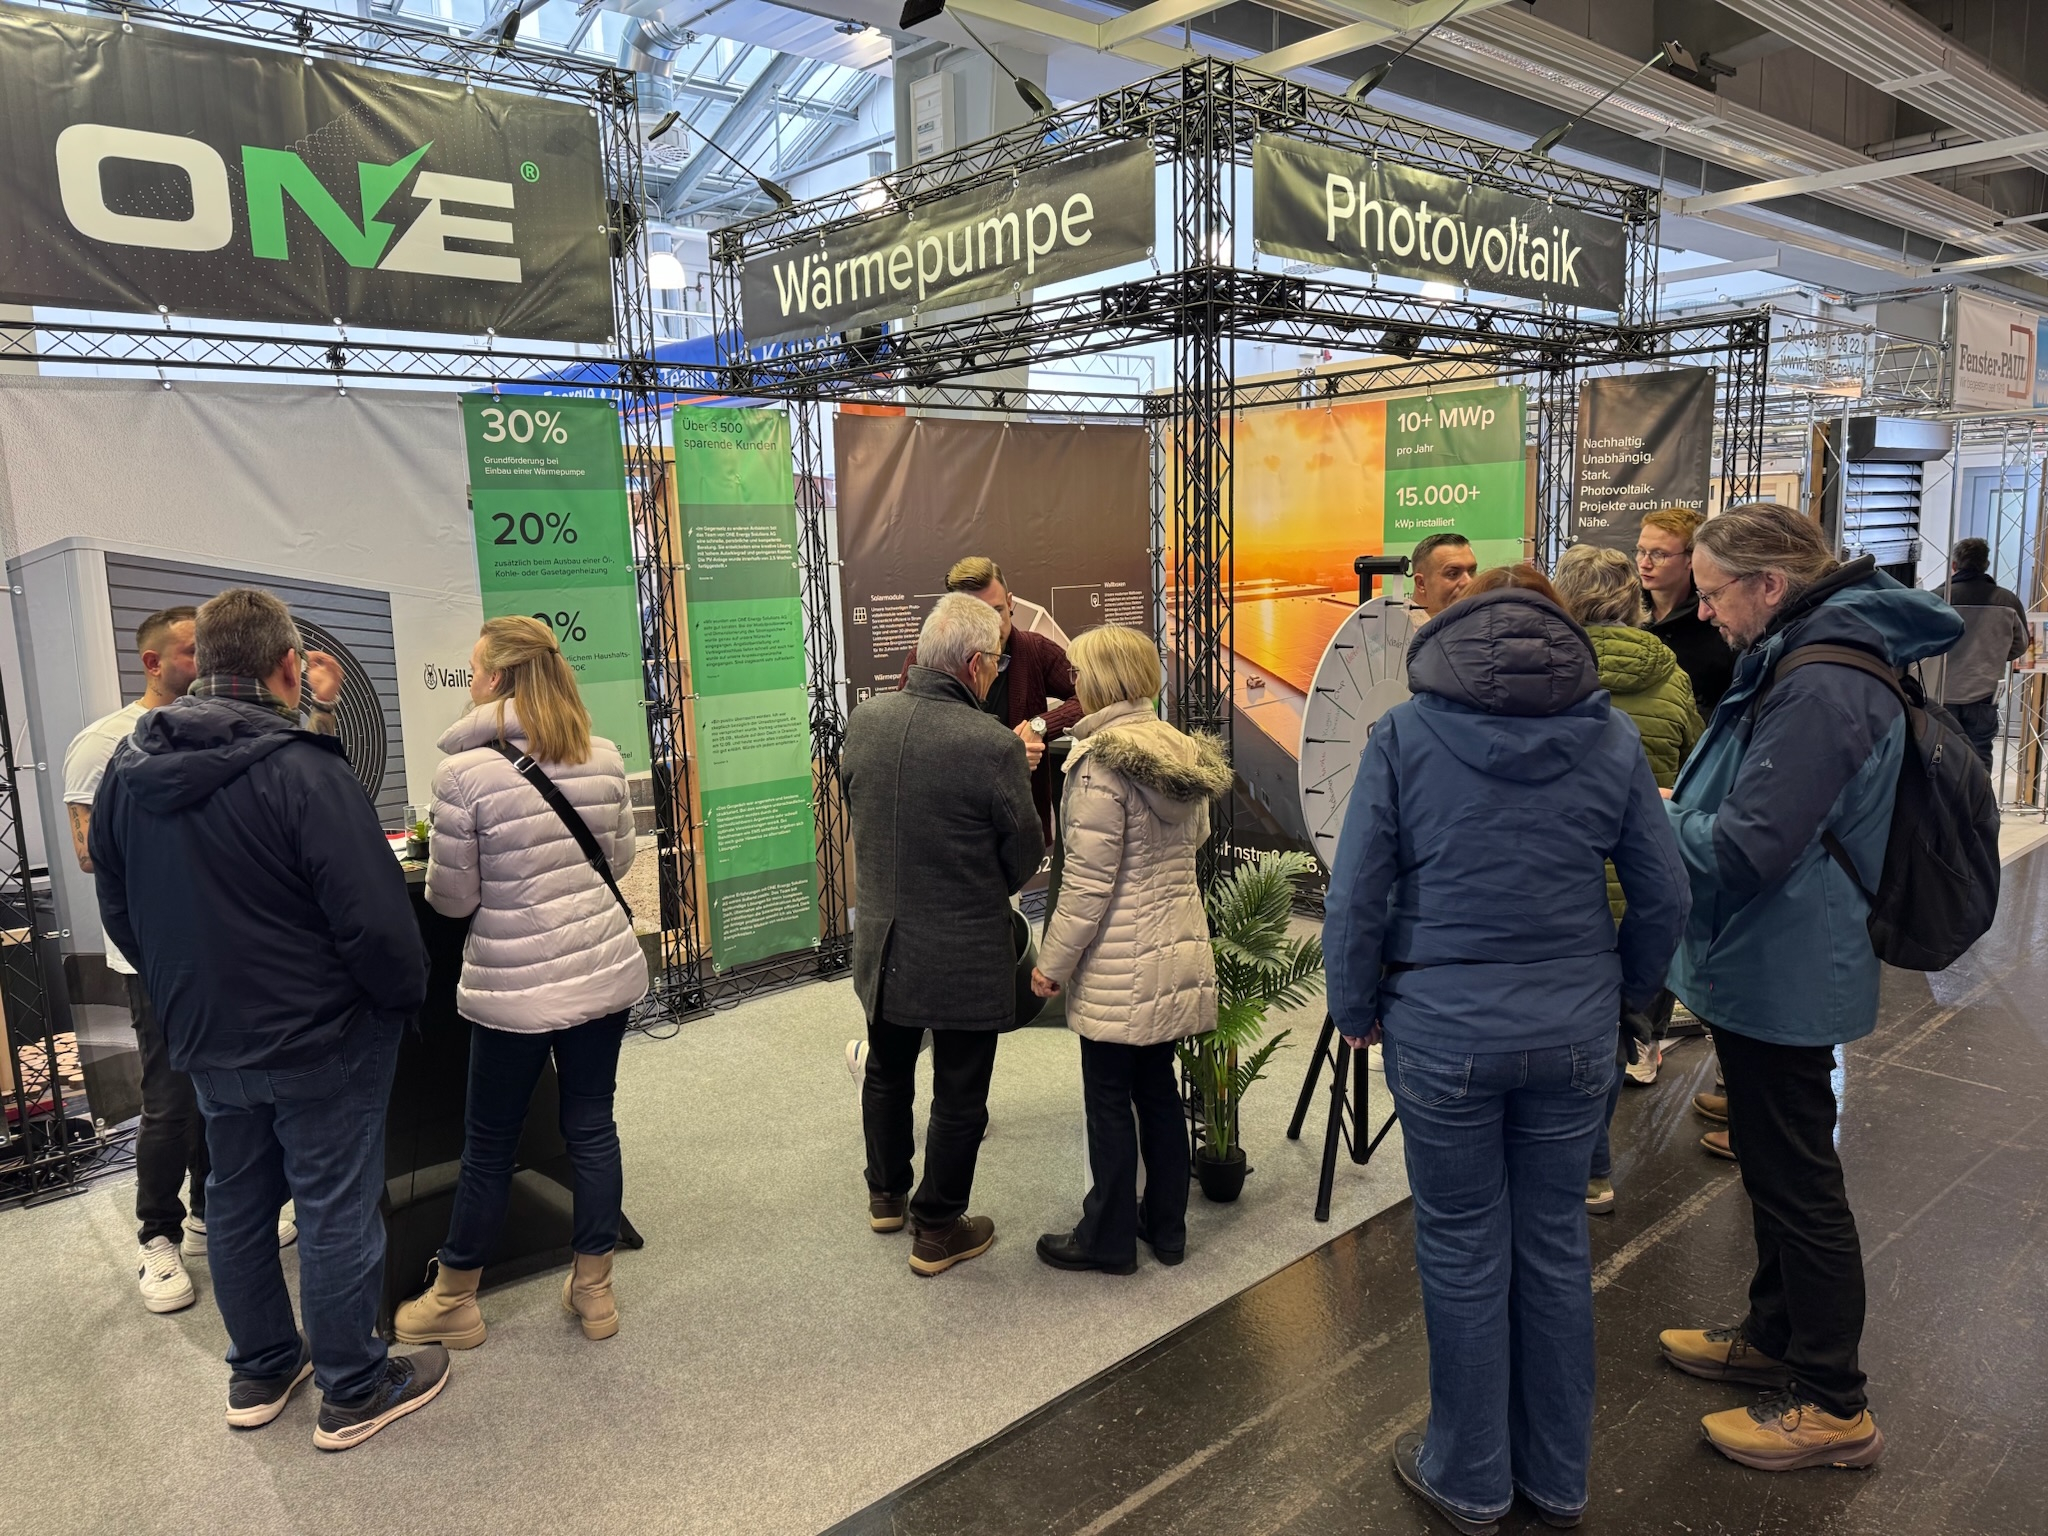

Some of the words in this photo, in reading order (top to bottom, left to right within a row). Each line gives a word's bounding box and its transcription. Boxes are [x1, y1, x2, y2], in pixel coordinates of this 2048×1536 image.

[1325, 173, 1582, 287] Photovoltaik
[773, 192, 1095, 317] Wärmepumpe
[1849, 338, 1860, 354] 22
[1958, 343, 2027, 382] Fenster-PAUL
[481, 408, 568, 444] 30%
[682, 419, 708, 433] Über
[711, 421, 743, 434] 3.500
[1397, 411, 1433, 434] 10+
[1439, 405, 1495, 432] MWp
[684, 438, 733, 450] sparende
[736, 438, 777, 450] Kunden
[1396, 446, 1412, 457] pro
[1413, 443, 1434, 455] Jahr
[1583, 436, 1645, 451] Nachhaltig.
[483, 456, 544, 467] Grundförderung
[546, 457, 559, 466] bei
[1582, 452, 1655, 467] Unabhängig.
[485, 467, 511, 476] Einbau
[513, 468, 532, 476] einer
[534, 467, 586, 478] Wärmepumpe
[1581, 469, 1611, 481] Stark.
[1396, 483, 1481, 507] 15.000+
[1580, 484, 1655, 497] Photovoltaik-
[1579, 500, 1627, 514] Projekte
[1629, 499, 1658, 510] auch
[1661, 499, 1672, 510] in
[1675, 498, 1704, 510] Ihrer
[491, 511, 578, 546] 20%
[1395, 519, 1414, 529] kWp
[1415, 517, 1455, 528] installiert
[1578, 516, 1610, 528] Nähe.
[494, 557, 534, 568] zusätzlich
[535, 557, 552, 566] beim
[553, 557, 581, 566] Ausbau
[582, 557, 600, 565] einer
[601, 556, 615, 566] Öl-,
[495, 569, 520, 578] Kohle-
[521, 568, 539, 577] oder
[540, 566, 608, 578] Gasetagenheizung
[870, 593, 905, 602] Solarmodule
[531, 611, 587, 643] 0%
[566, 653, 593, 662] rlichem
[594, 651, 631, 660] Haushalts-
[438, 668, 474, 688] Vailla
[873, 673, 902, 682] Wärmepu
